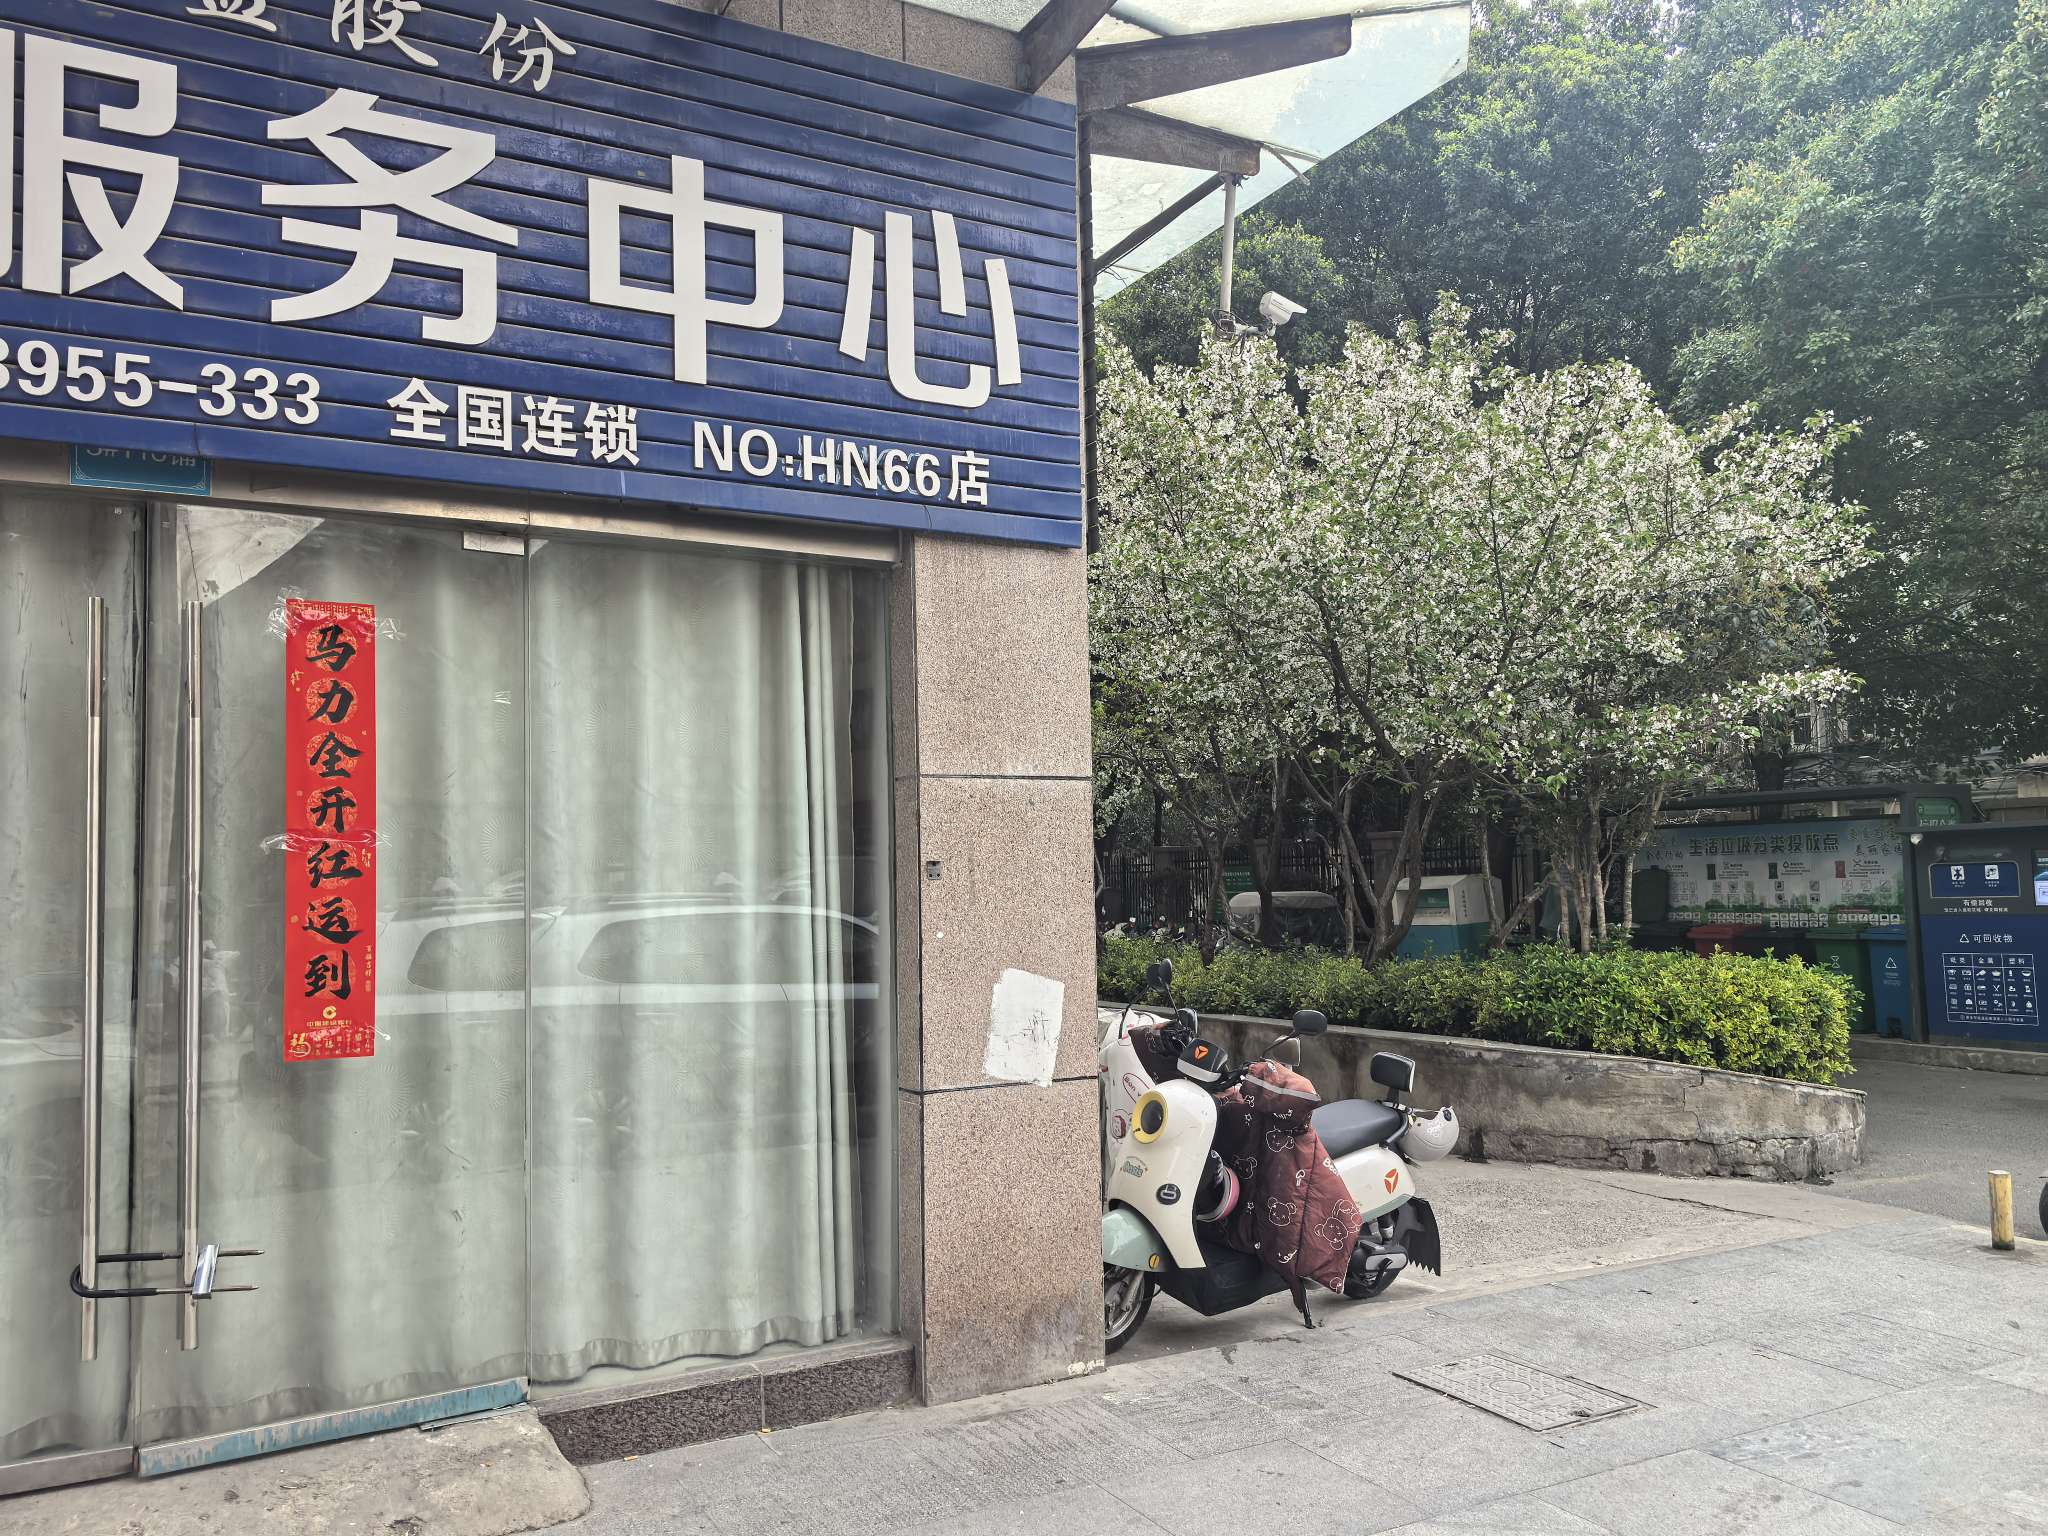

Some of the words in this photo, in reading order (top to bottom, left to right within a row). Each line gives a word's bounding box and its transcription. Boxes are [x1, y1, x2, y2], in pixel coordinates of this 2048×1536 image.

[0, 28, 1022, 410] 服务中心
[387, 377, 640, 467] 全国连锁
[692, 420, 991, 507] NO:HN66店
[302, 624, 364, 1000] 马力全开红运到
[1688, 833, 1841, 857] 生活垃圾分类投放点
[1973, 934, 2013, 943] 可回收物
